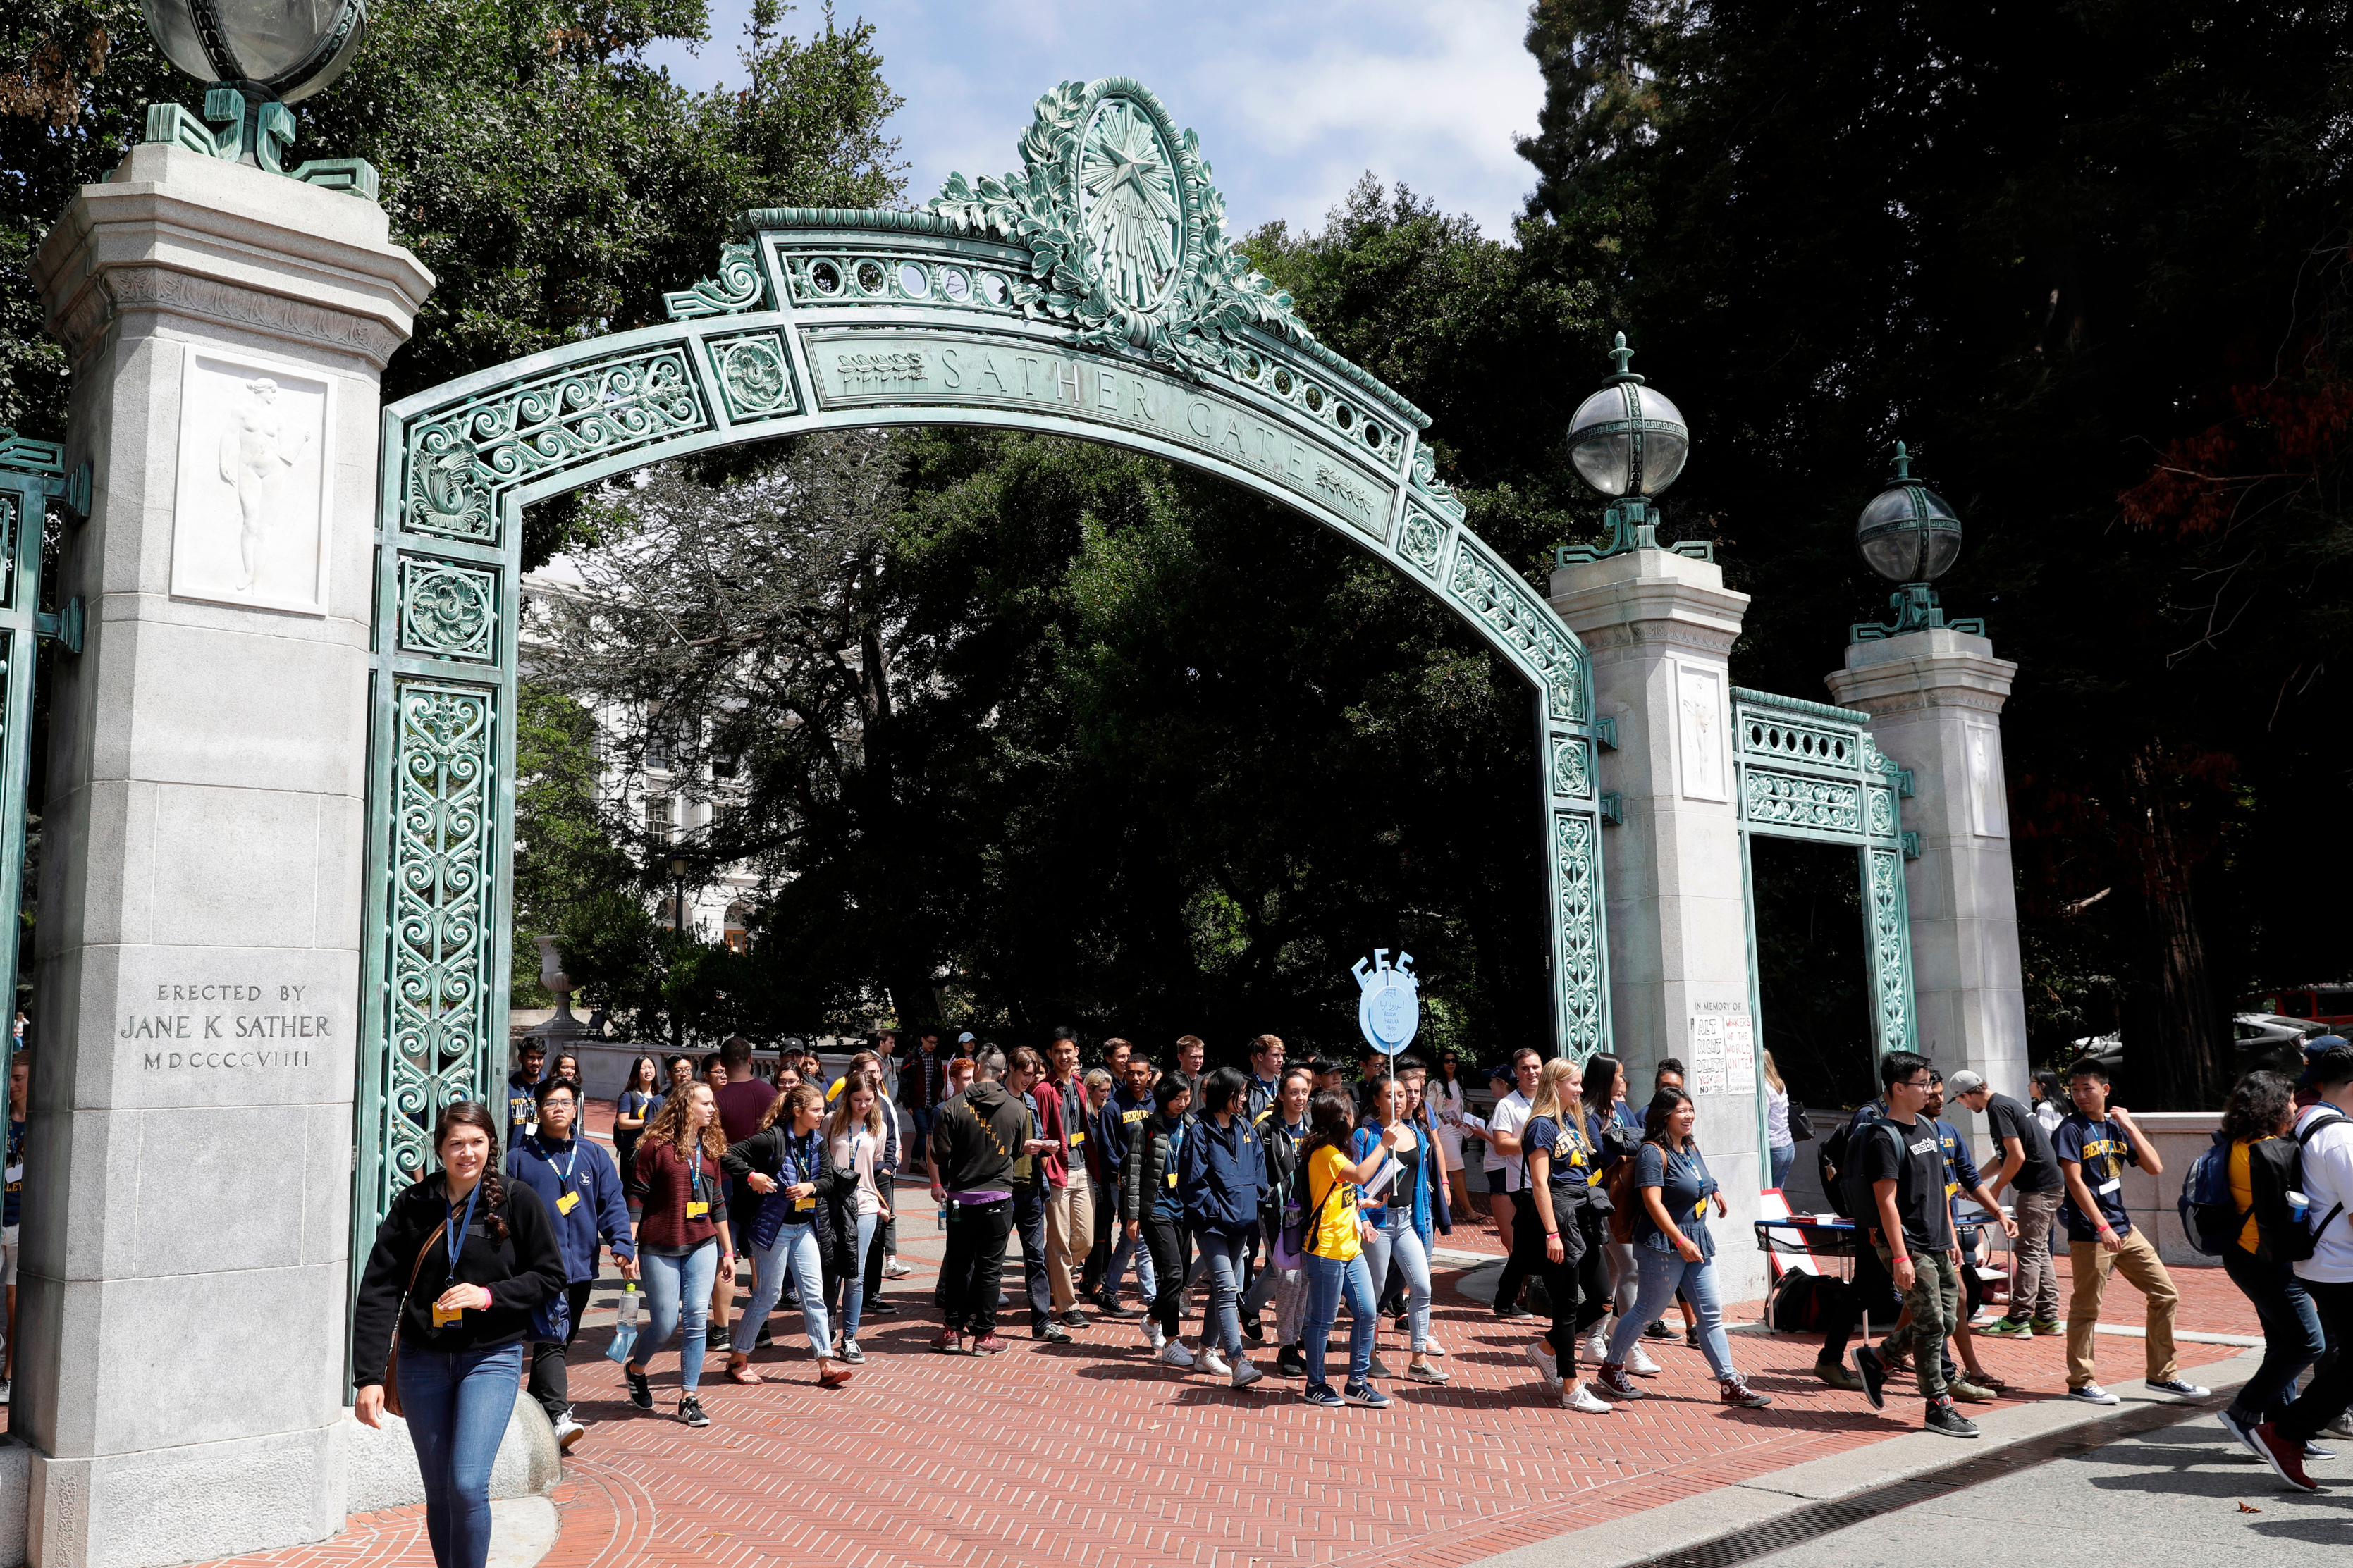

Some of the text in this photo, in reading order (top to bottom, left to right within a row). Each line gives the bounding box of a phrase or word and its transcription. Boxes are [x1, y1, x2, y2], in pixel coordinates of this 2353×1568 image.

[942, 347, 1306, 481] SATHER GATE
[156, 984, 307, 1001] ERECTED BY
[1695, 1002, 1741, 1011] IN MEMORY OF
[121, 1014, 333, 1039] JANE K SATHER
[1698, 1019, 1716, 1035] ALT
[1725, 1017, 1751, 1027] WORKERS
[1726, 1032, 1748, 1041] OF THE
[1697, 1038, 1721, 1055] RIGHT
[1726, 1043, 1752, 1054] WORLD
[1696, 1058, 1724, 1073] DELETE
[1698, 1075, 1709, 1085] YES
[1910, 1137, 1938, 1156] weebly
